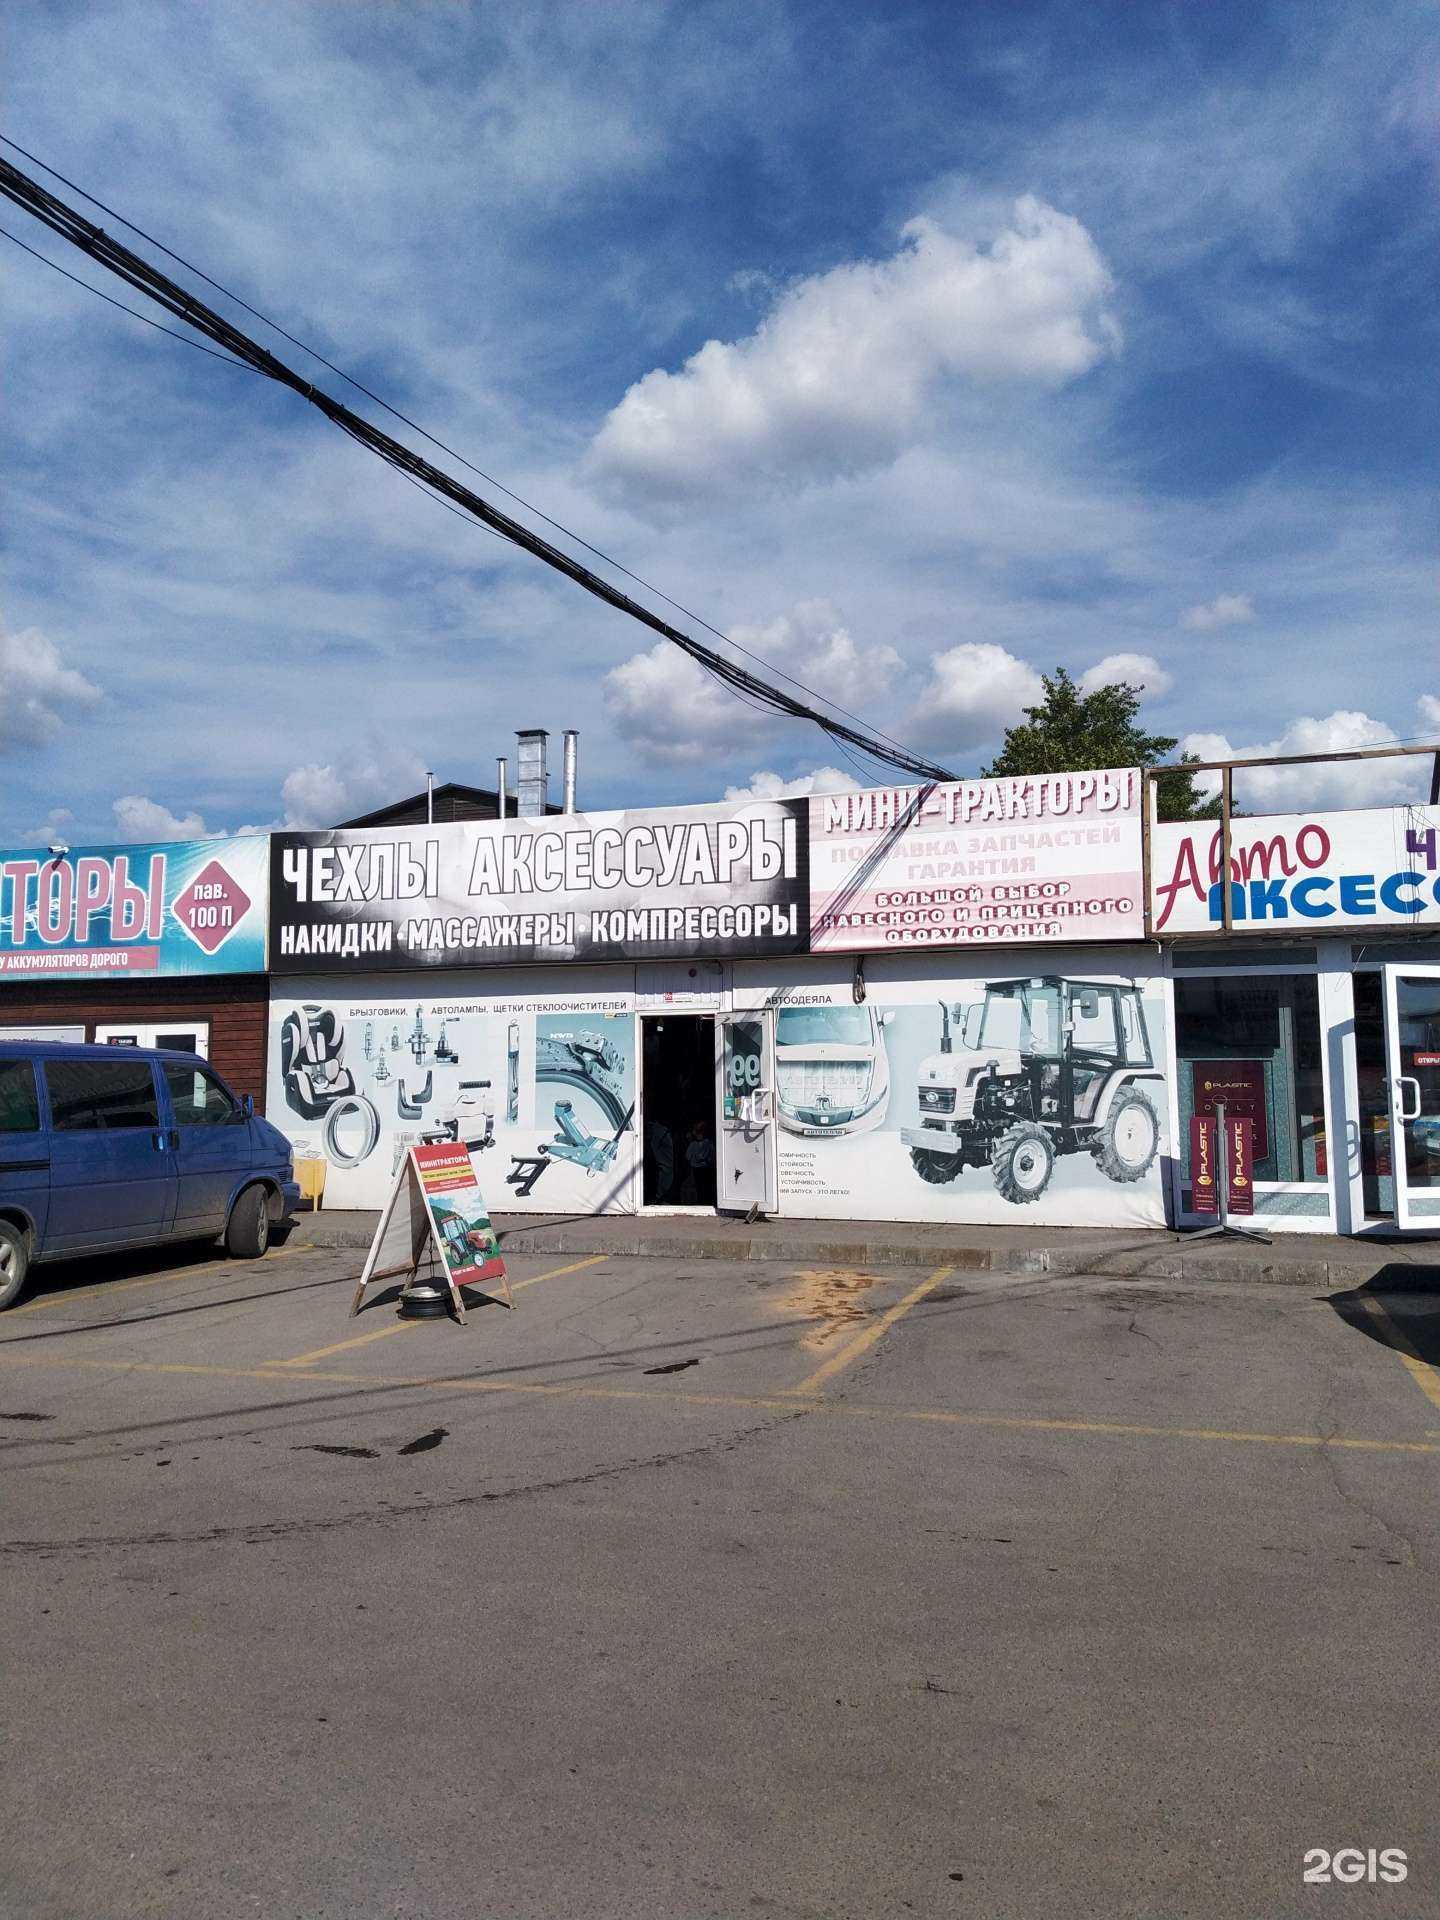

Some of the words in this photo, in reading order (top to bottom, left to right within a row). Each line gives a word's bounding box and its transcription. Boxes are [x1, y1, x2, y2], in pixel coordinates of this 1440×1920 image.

[823, 772, 1132, 832] МИНИ-ТРАКТОРЫ
[831, 838, 960, 863] ПОАВКА
[968, 822, 1121, 854] ЗАПЧАСТЕЙ
[282, 841, 439, 903] ЧЕХЛЫ
[468, 817, 798, 897] АКСЕССУАРЫ
[908, 856, 1036, 880] ГАРАНТИЯ
[0, 854, 167, 943] ТОРЫ
[194, 884, 228, 900] пав.
[876, 884, 983, 908] БОЛЬШОЙ
[994, 881, 1072, 901] ВЫБОР
[1209, 871, 1440, 922] АКСЕС
[189, 905, 217, 928] 100
[221, 905, 233, 927] П
[822, 908, 945, 928] НАВЕСНОГО
[956, 908, 969, 922] И
[979, 898, 1134, 922] ПРИЦЕПНОГО
[280, 921, 392, 957] НАКИДКИ
[407, 912, 575, 950] МАССАЖЕРЫ
[591, 903, 798, 943] КОМПРЕССОРЫ
[886, 922, 1062, 944] ОБОРУДОВАНИЯ
[7, 954, 88, 969] АККУМУЛЯТОРОВ
[90, 952, 129, 968] ДОРОГО
[349, 1007, 408, 1017] БРЫЗГОВИКИ,
[431, 1006, 489, 1016] АВТОЛАМПЫ,
[493, 1004, 524, 1013] ЩЕТКИ
[525, 1001, 627, 1012] СТЕКЛООЧИСТИТЕЛЕЙ
[765, 995, 832, 1005] АВТООДЕЯЛА
[1235, 1122, 1243, 1176] PLASTIC
